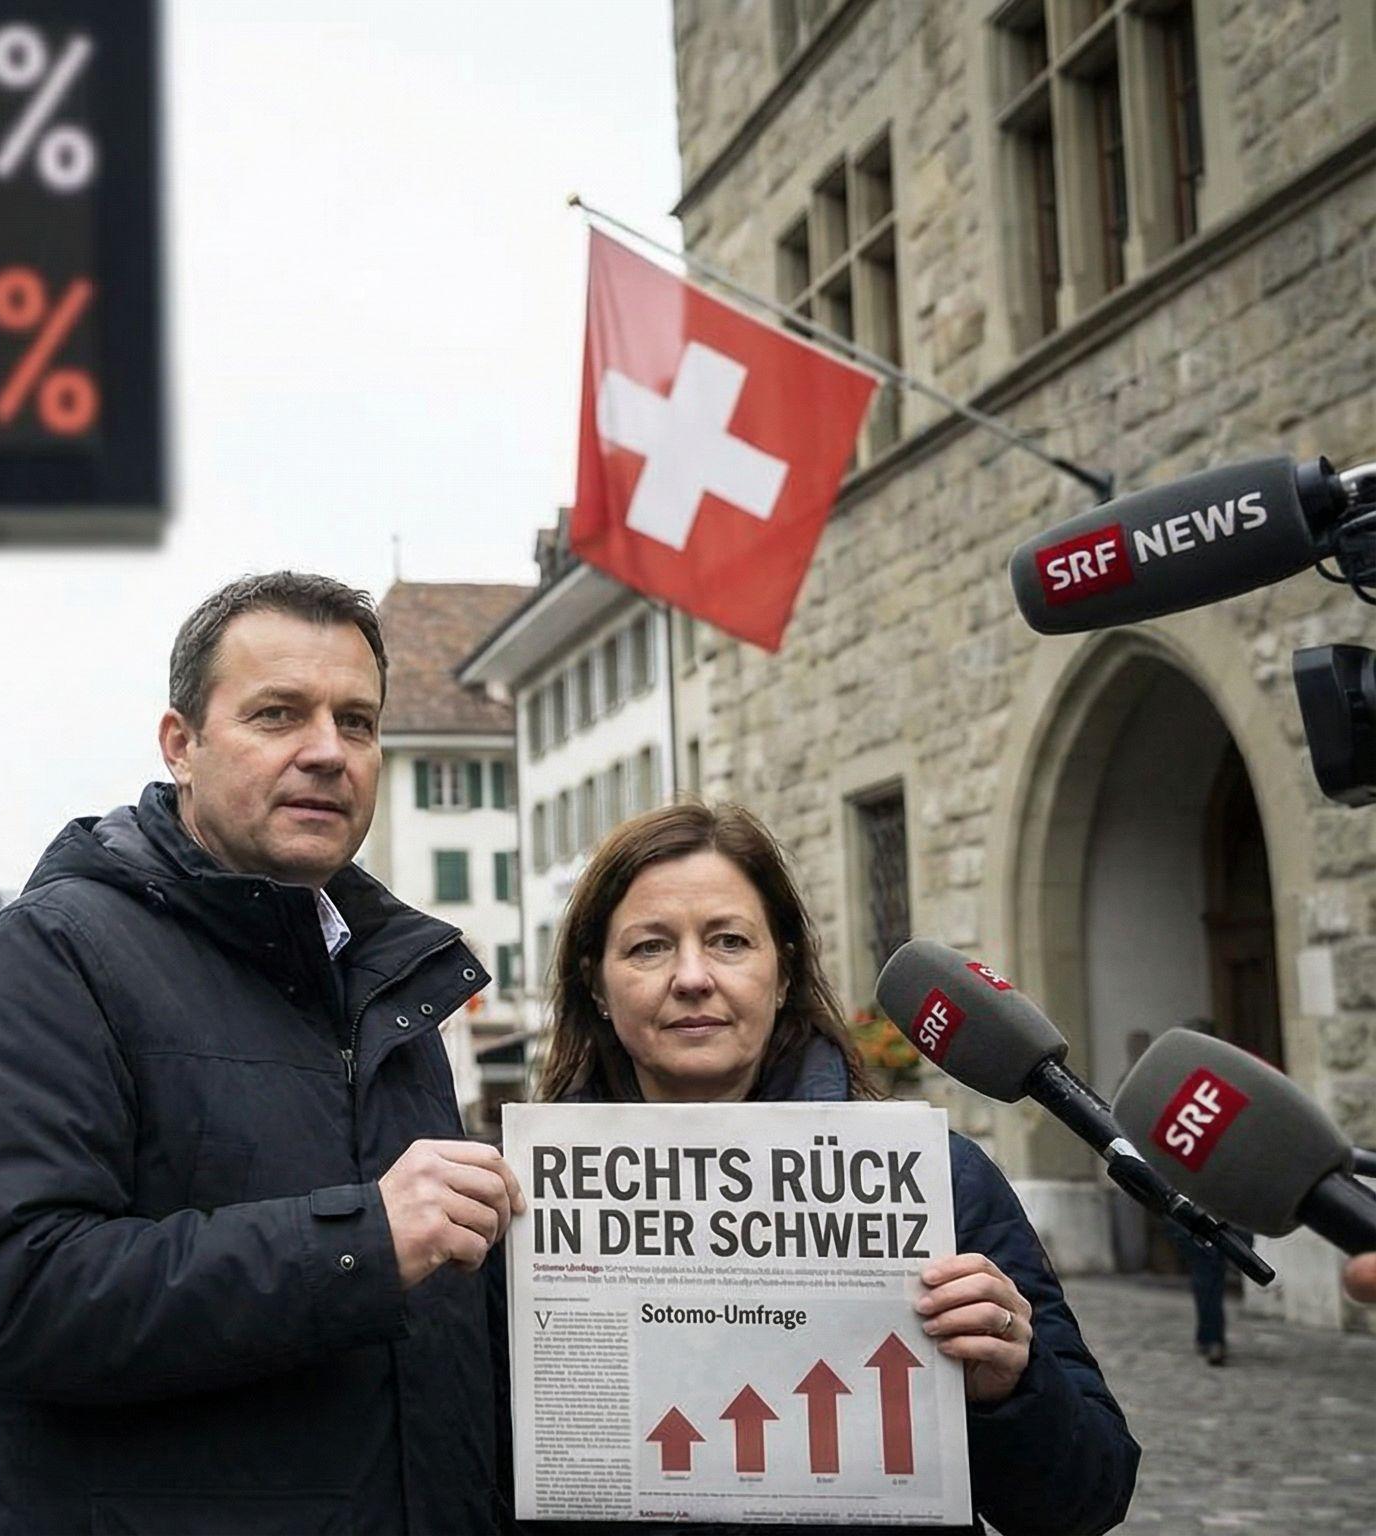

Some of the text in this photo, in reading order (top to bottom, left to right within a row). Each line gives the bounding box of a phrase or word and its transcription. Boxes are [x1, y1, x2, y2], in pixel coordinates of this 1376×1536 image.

[1045, 491, 1268, 591] SRF NEWS
[918, 1001, 951, 1052] SRF
[1165, 1079, 1223, 1157] SRF
[532, 1135, 926, 1204] RECHTS RÜCK
[533, 1208, 930, 1259] IN DER SCHWEIZ
[641, 1303, 807, 1330] Sotomo-Umfrage
